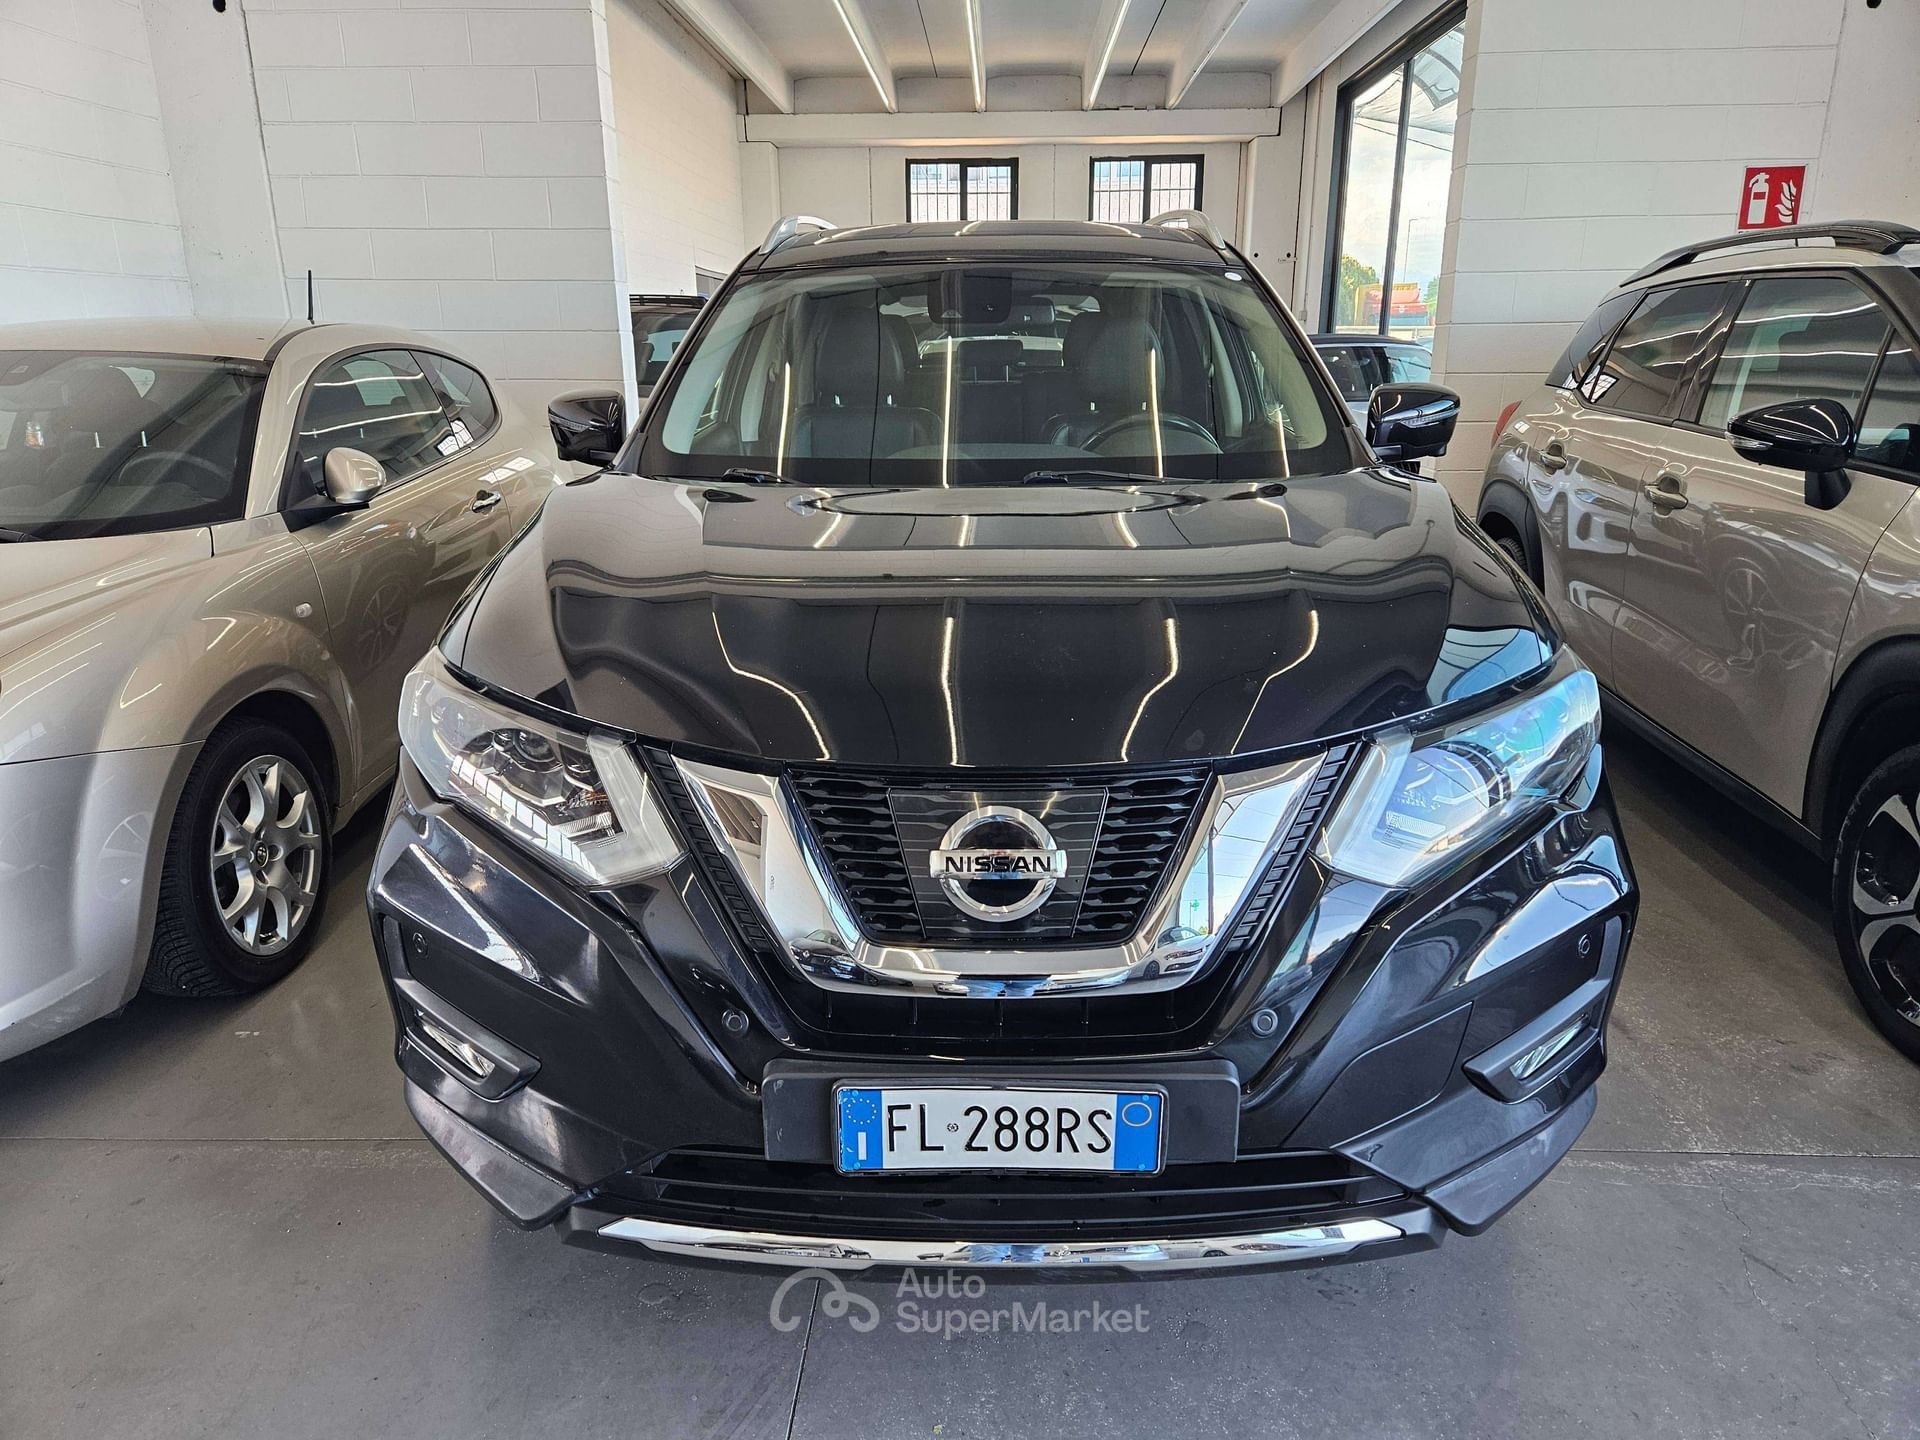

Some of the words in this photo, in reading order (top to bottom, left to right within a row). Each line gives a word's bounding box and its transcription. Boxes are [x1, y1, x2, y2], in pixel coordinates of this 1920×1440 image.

[945, 856, 1050, 873] NISSAN
[887, 1104, 944, 1152] FL
[964, 1105, 1113, 1154] 288RS
